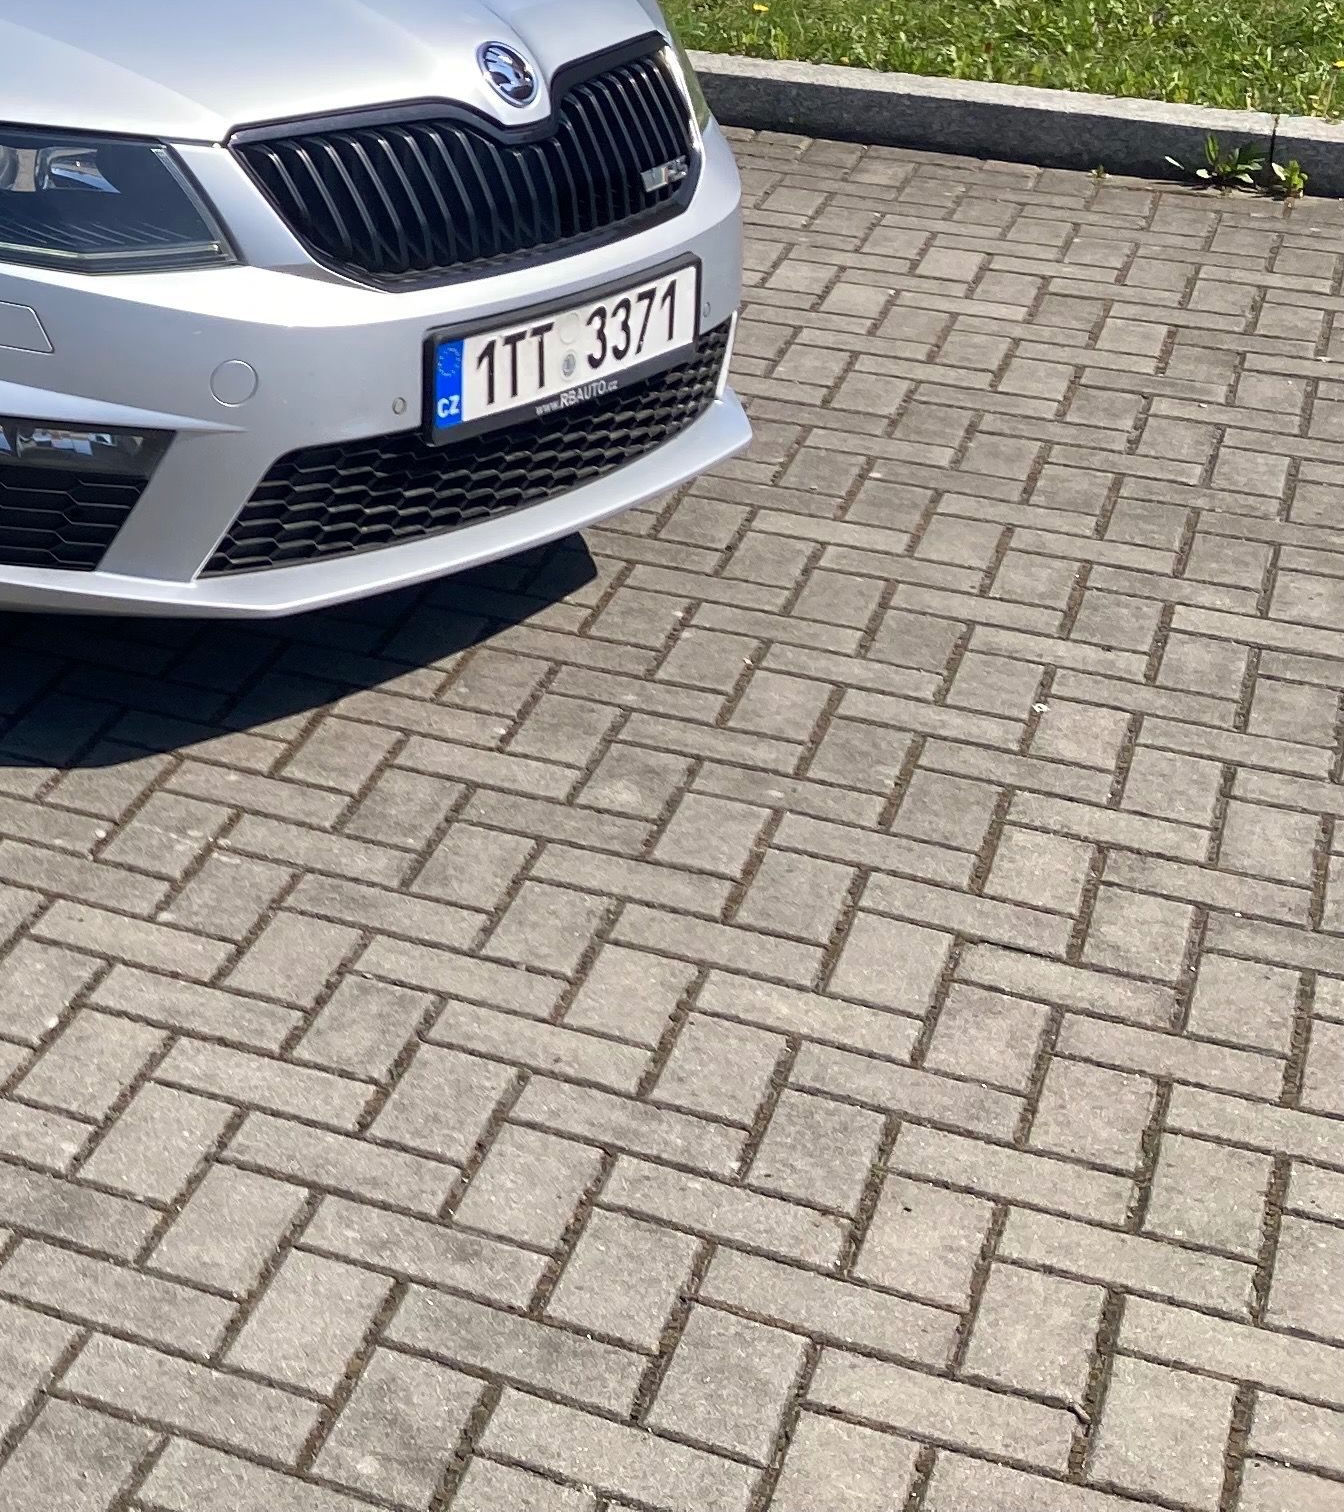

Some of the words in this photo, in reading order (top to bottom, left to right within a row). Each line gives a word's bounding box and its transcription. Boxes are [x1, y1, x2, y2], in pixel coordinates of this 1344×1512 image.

[476, 321, 555, 406] 1TT
[585, 278, 677, 370] 3371
[436, 394, 461, 419] CZ
